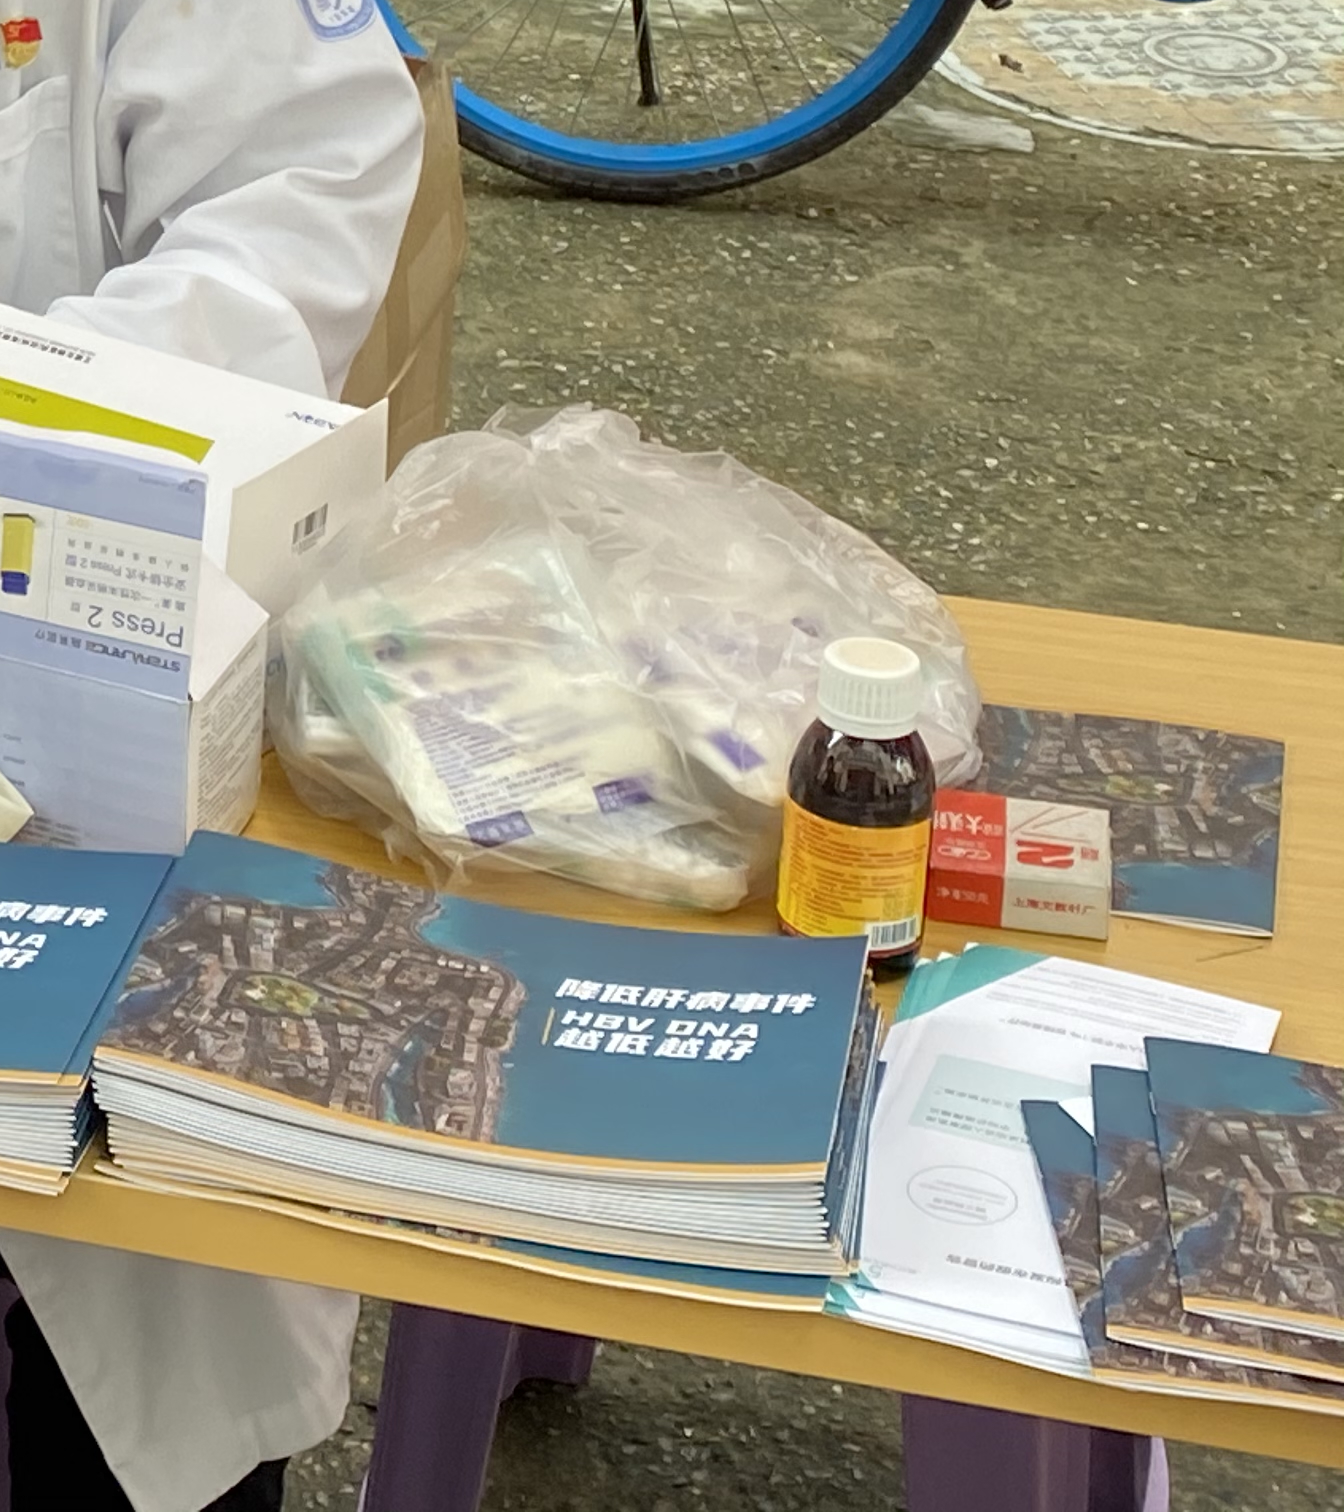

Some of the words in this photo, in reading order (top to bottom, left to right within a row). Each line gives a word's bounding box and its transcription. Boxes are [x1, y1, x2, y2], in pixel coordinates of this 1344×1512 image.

[87, 604, 104, 629] 2
[112, 609, 184, 649] Press
[555, 978, 818, 1015] 降低肝病事件
[561, 1009, 656, 1033] HBV
[664, 1019, 760, 1039] DNA
[553, 1027, 757, 1062] 越低越好
